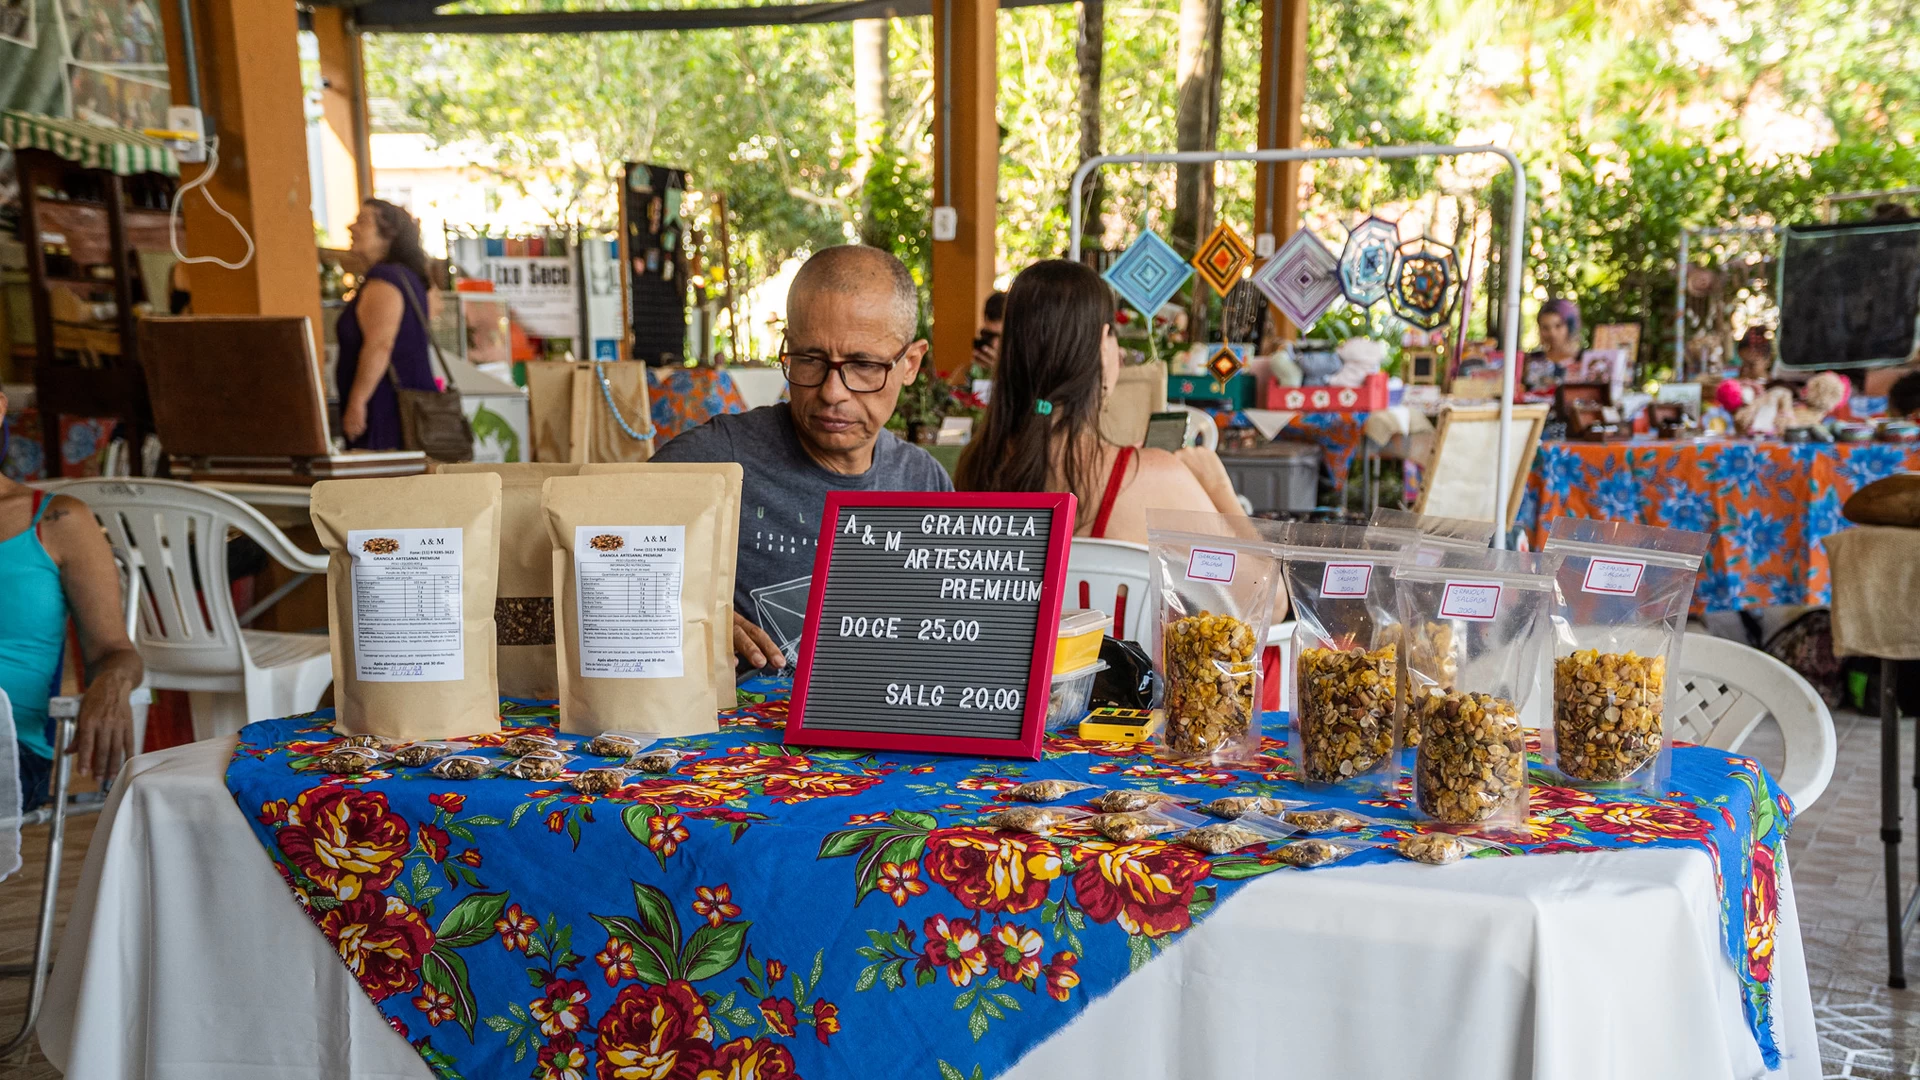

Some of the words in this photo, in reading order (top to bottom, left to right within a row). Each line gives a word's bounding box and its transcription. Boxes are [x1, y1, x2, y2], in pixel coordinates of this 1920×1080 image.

[530, 262, 570, 286] Seco
[844, 514, 857, 534] A
[862, 524, 876, 545] &
[884, 531, 902, 552] M
[921, 514, 1036, 537] GRANOLA
[904, 548, 1030, 572] ARTESANAL
[940, 578, 1043, 602] PREMIUM
[840, 616, 901, 638] DOCE
[918, 618, 980, 642] 25,00
[886, 683, 944, 706] SALG
[959, 687, 1020, 711] 20,00
